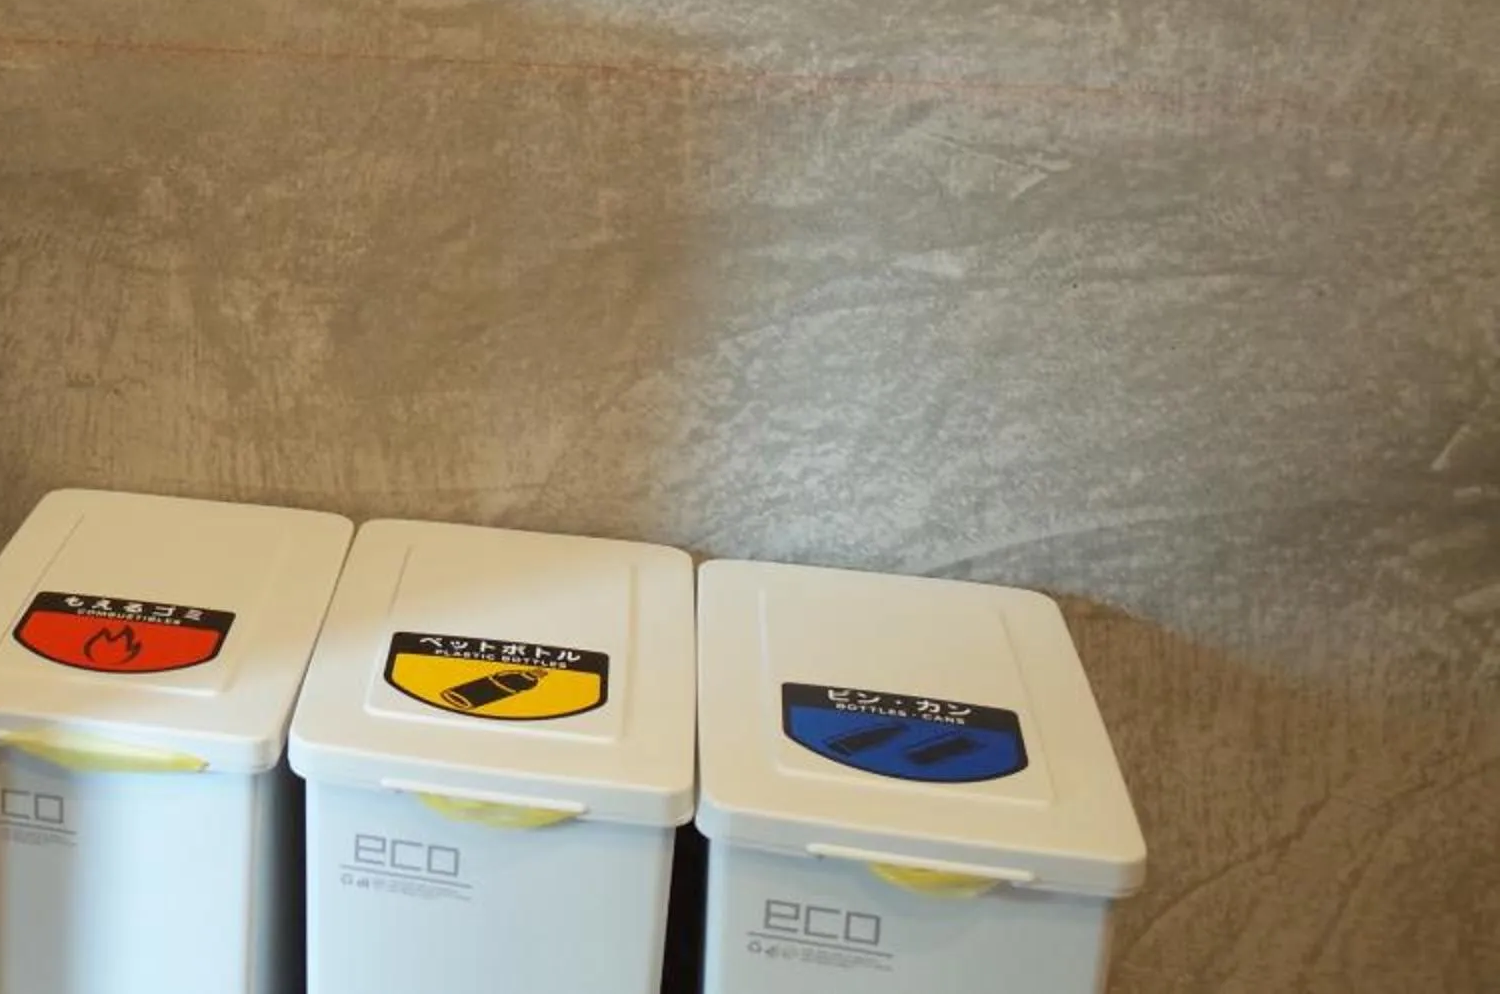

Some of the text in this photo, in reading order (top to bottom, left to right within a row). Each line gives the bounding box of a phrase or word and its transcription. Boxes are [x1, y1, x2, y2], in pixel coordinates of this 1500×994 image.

[64, 595, 204, 622] もえるゴミ
[77, 608, 182, 626] COMBUSTIBLES
[419, 636, 581, 663] ペットボトル
[435, 648, 568, 670] PLASTIC BOTTLES
[827, 688, 973, 717] ビン・カン
[835, 703, 966, 726] BOTTLES CANS
[353, 832, 462, 878] eco
[763, 898, 882, 947] eco
